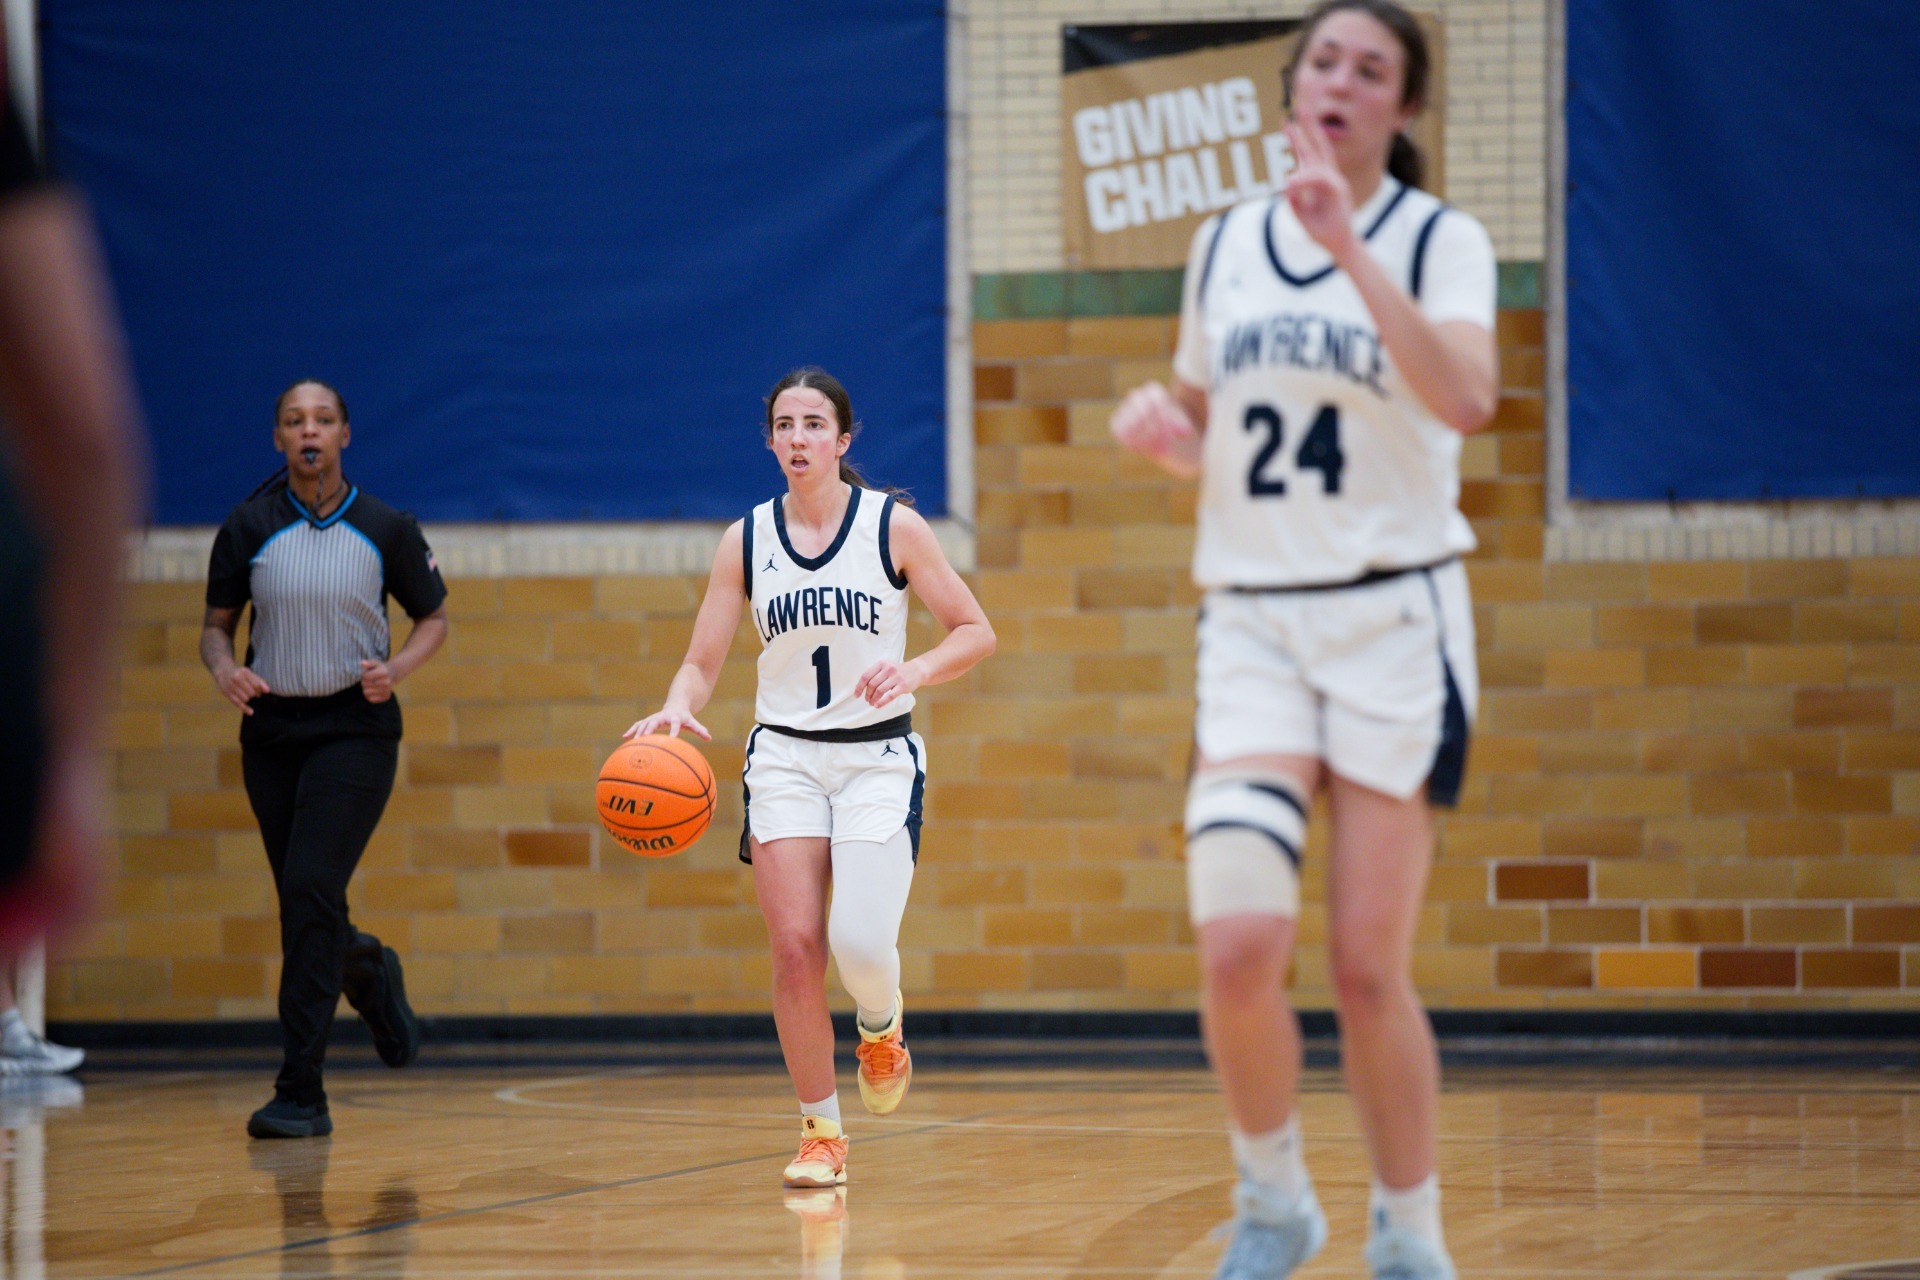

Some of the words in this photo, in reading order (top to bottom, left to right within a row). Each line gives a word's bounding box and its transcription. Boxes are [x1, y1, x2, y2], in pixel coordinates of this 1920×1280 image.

[1073, 76, 1261, 168] GIVING
[1243, 402, 1345, 497] 24
[756, 586, 883, 643] LAWRENCE
[811, 645, 832, 710] 1
[608, 794, 654, 817] EVO
